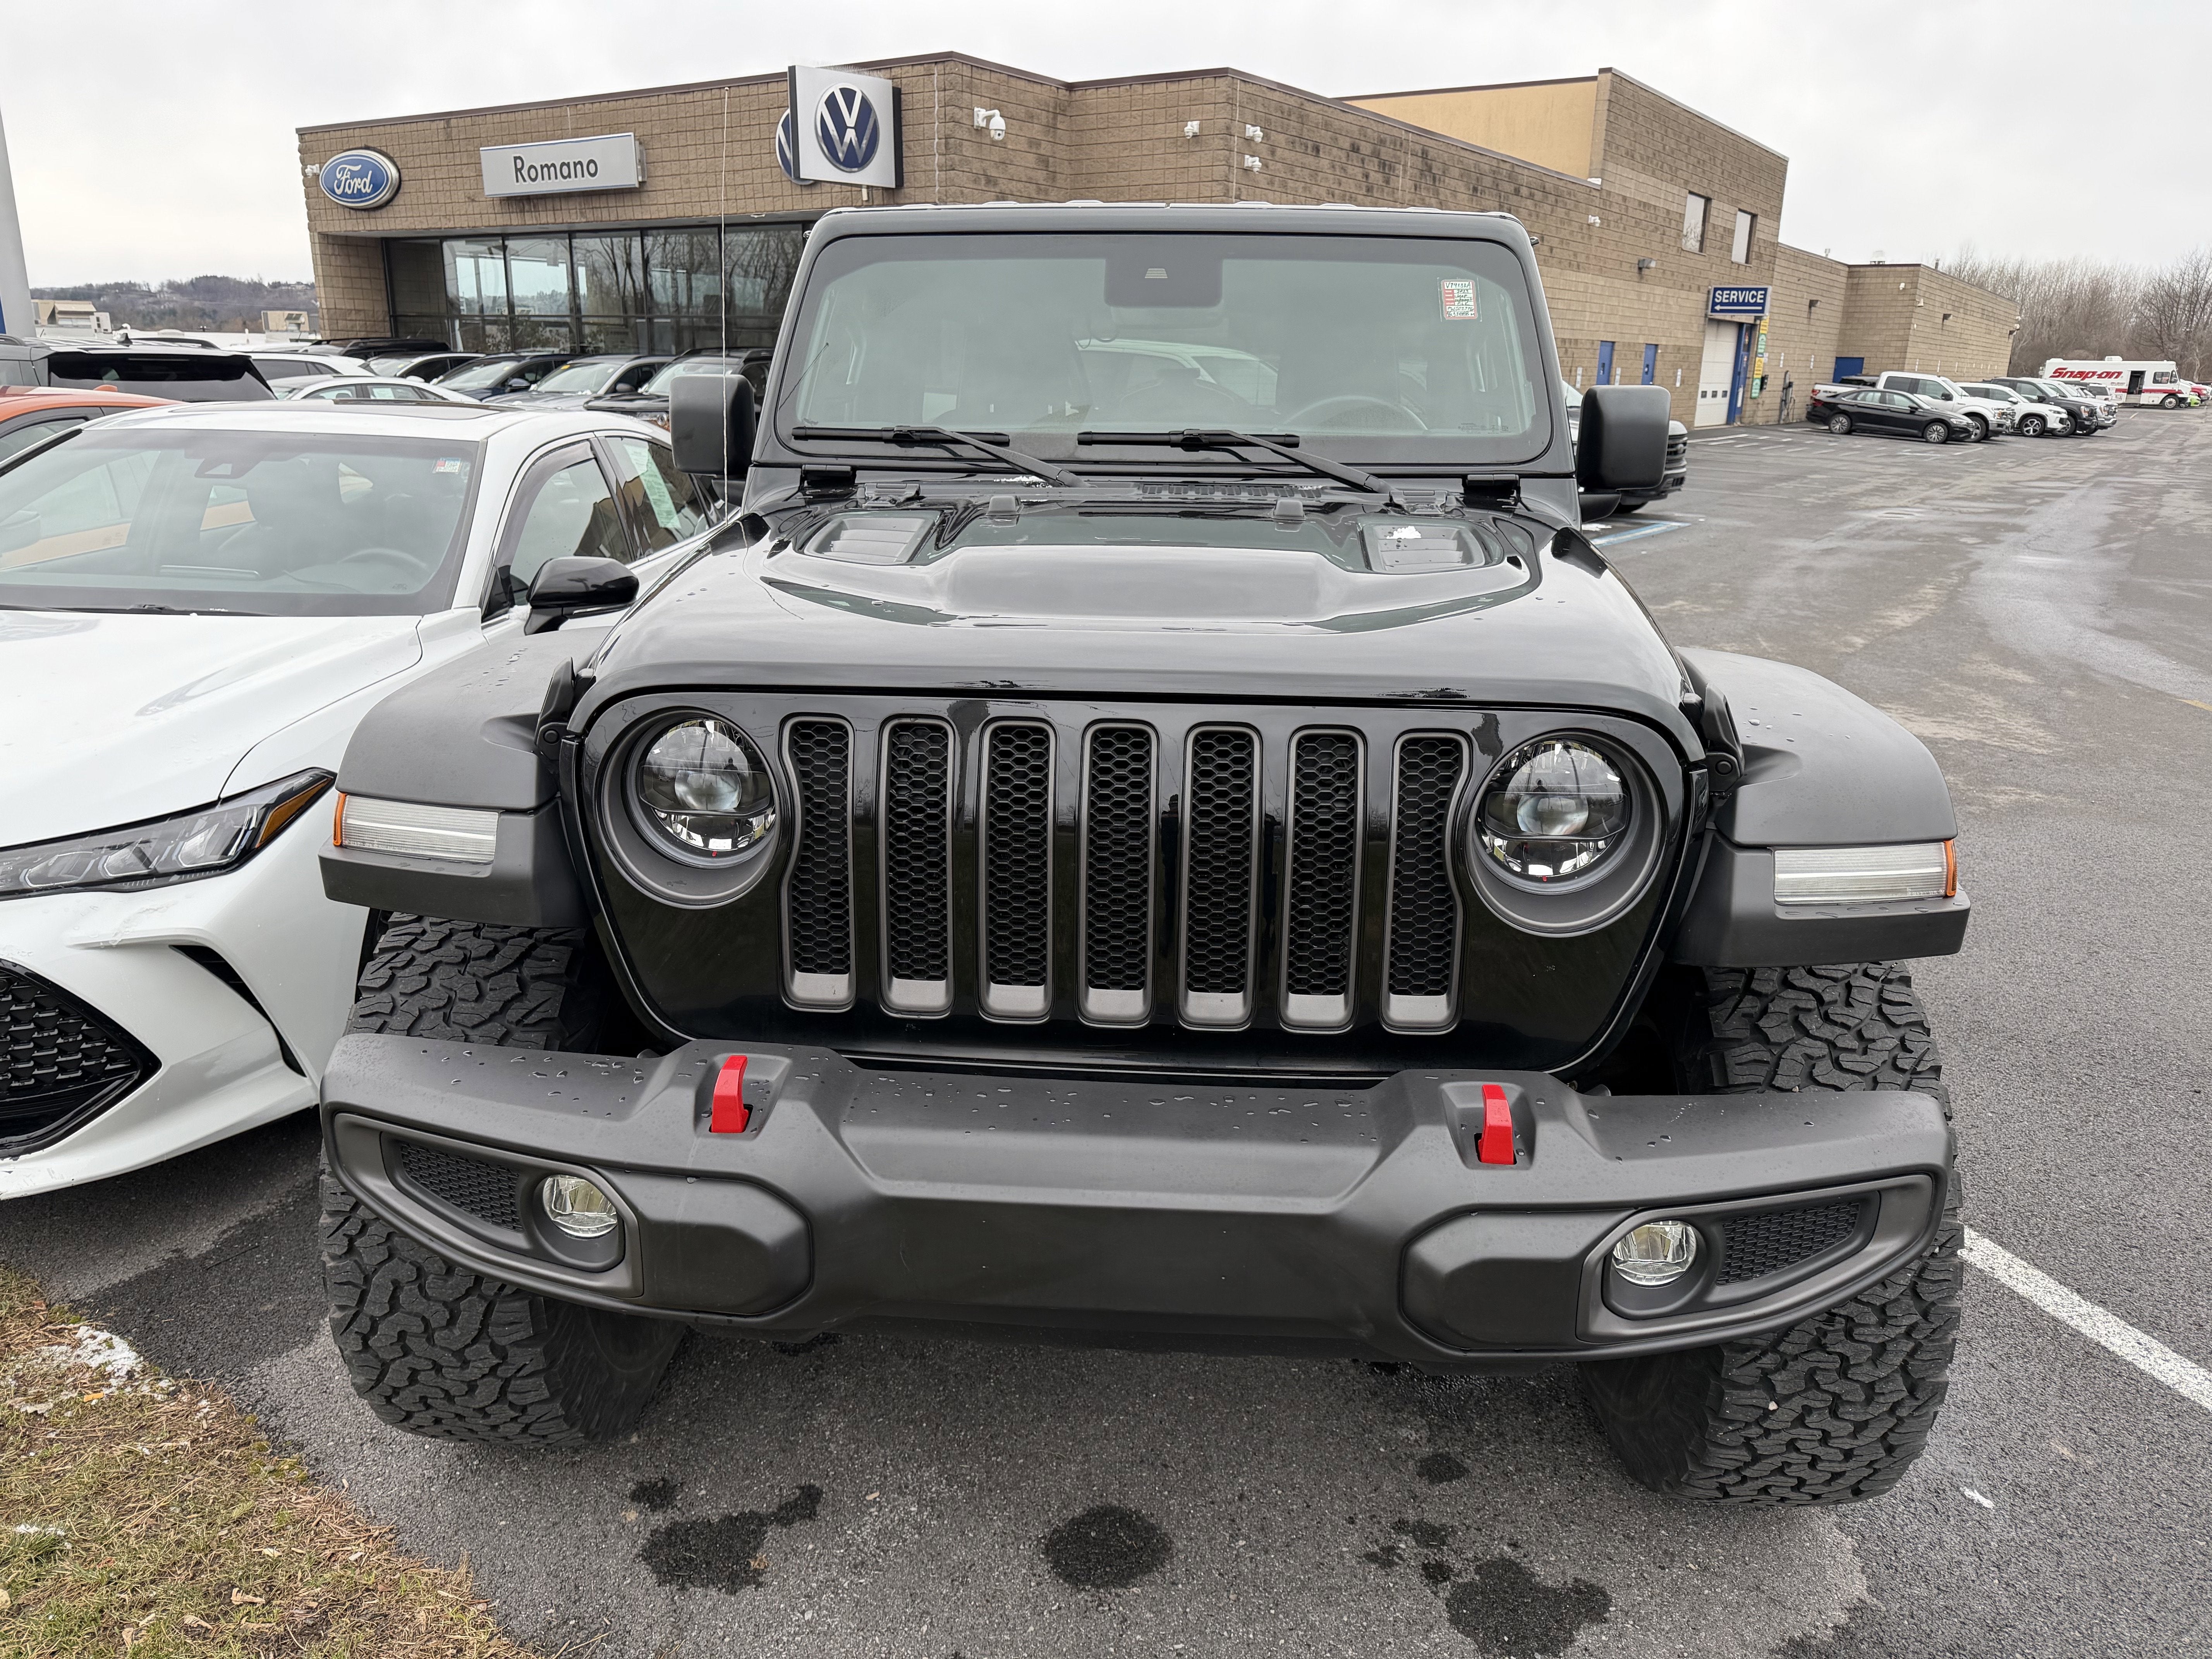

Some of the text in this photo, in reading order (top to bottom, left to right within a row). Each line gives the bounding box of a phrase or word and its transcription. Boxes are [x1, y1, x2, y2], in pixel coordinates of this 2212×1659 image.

[333, 164, 373, 195] Ford
[513, 155, 598, 183] Romano
[1714, 290, 1765, 303] SERVICE
[2049, 367, 2123, 381] Snap-on
